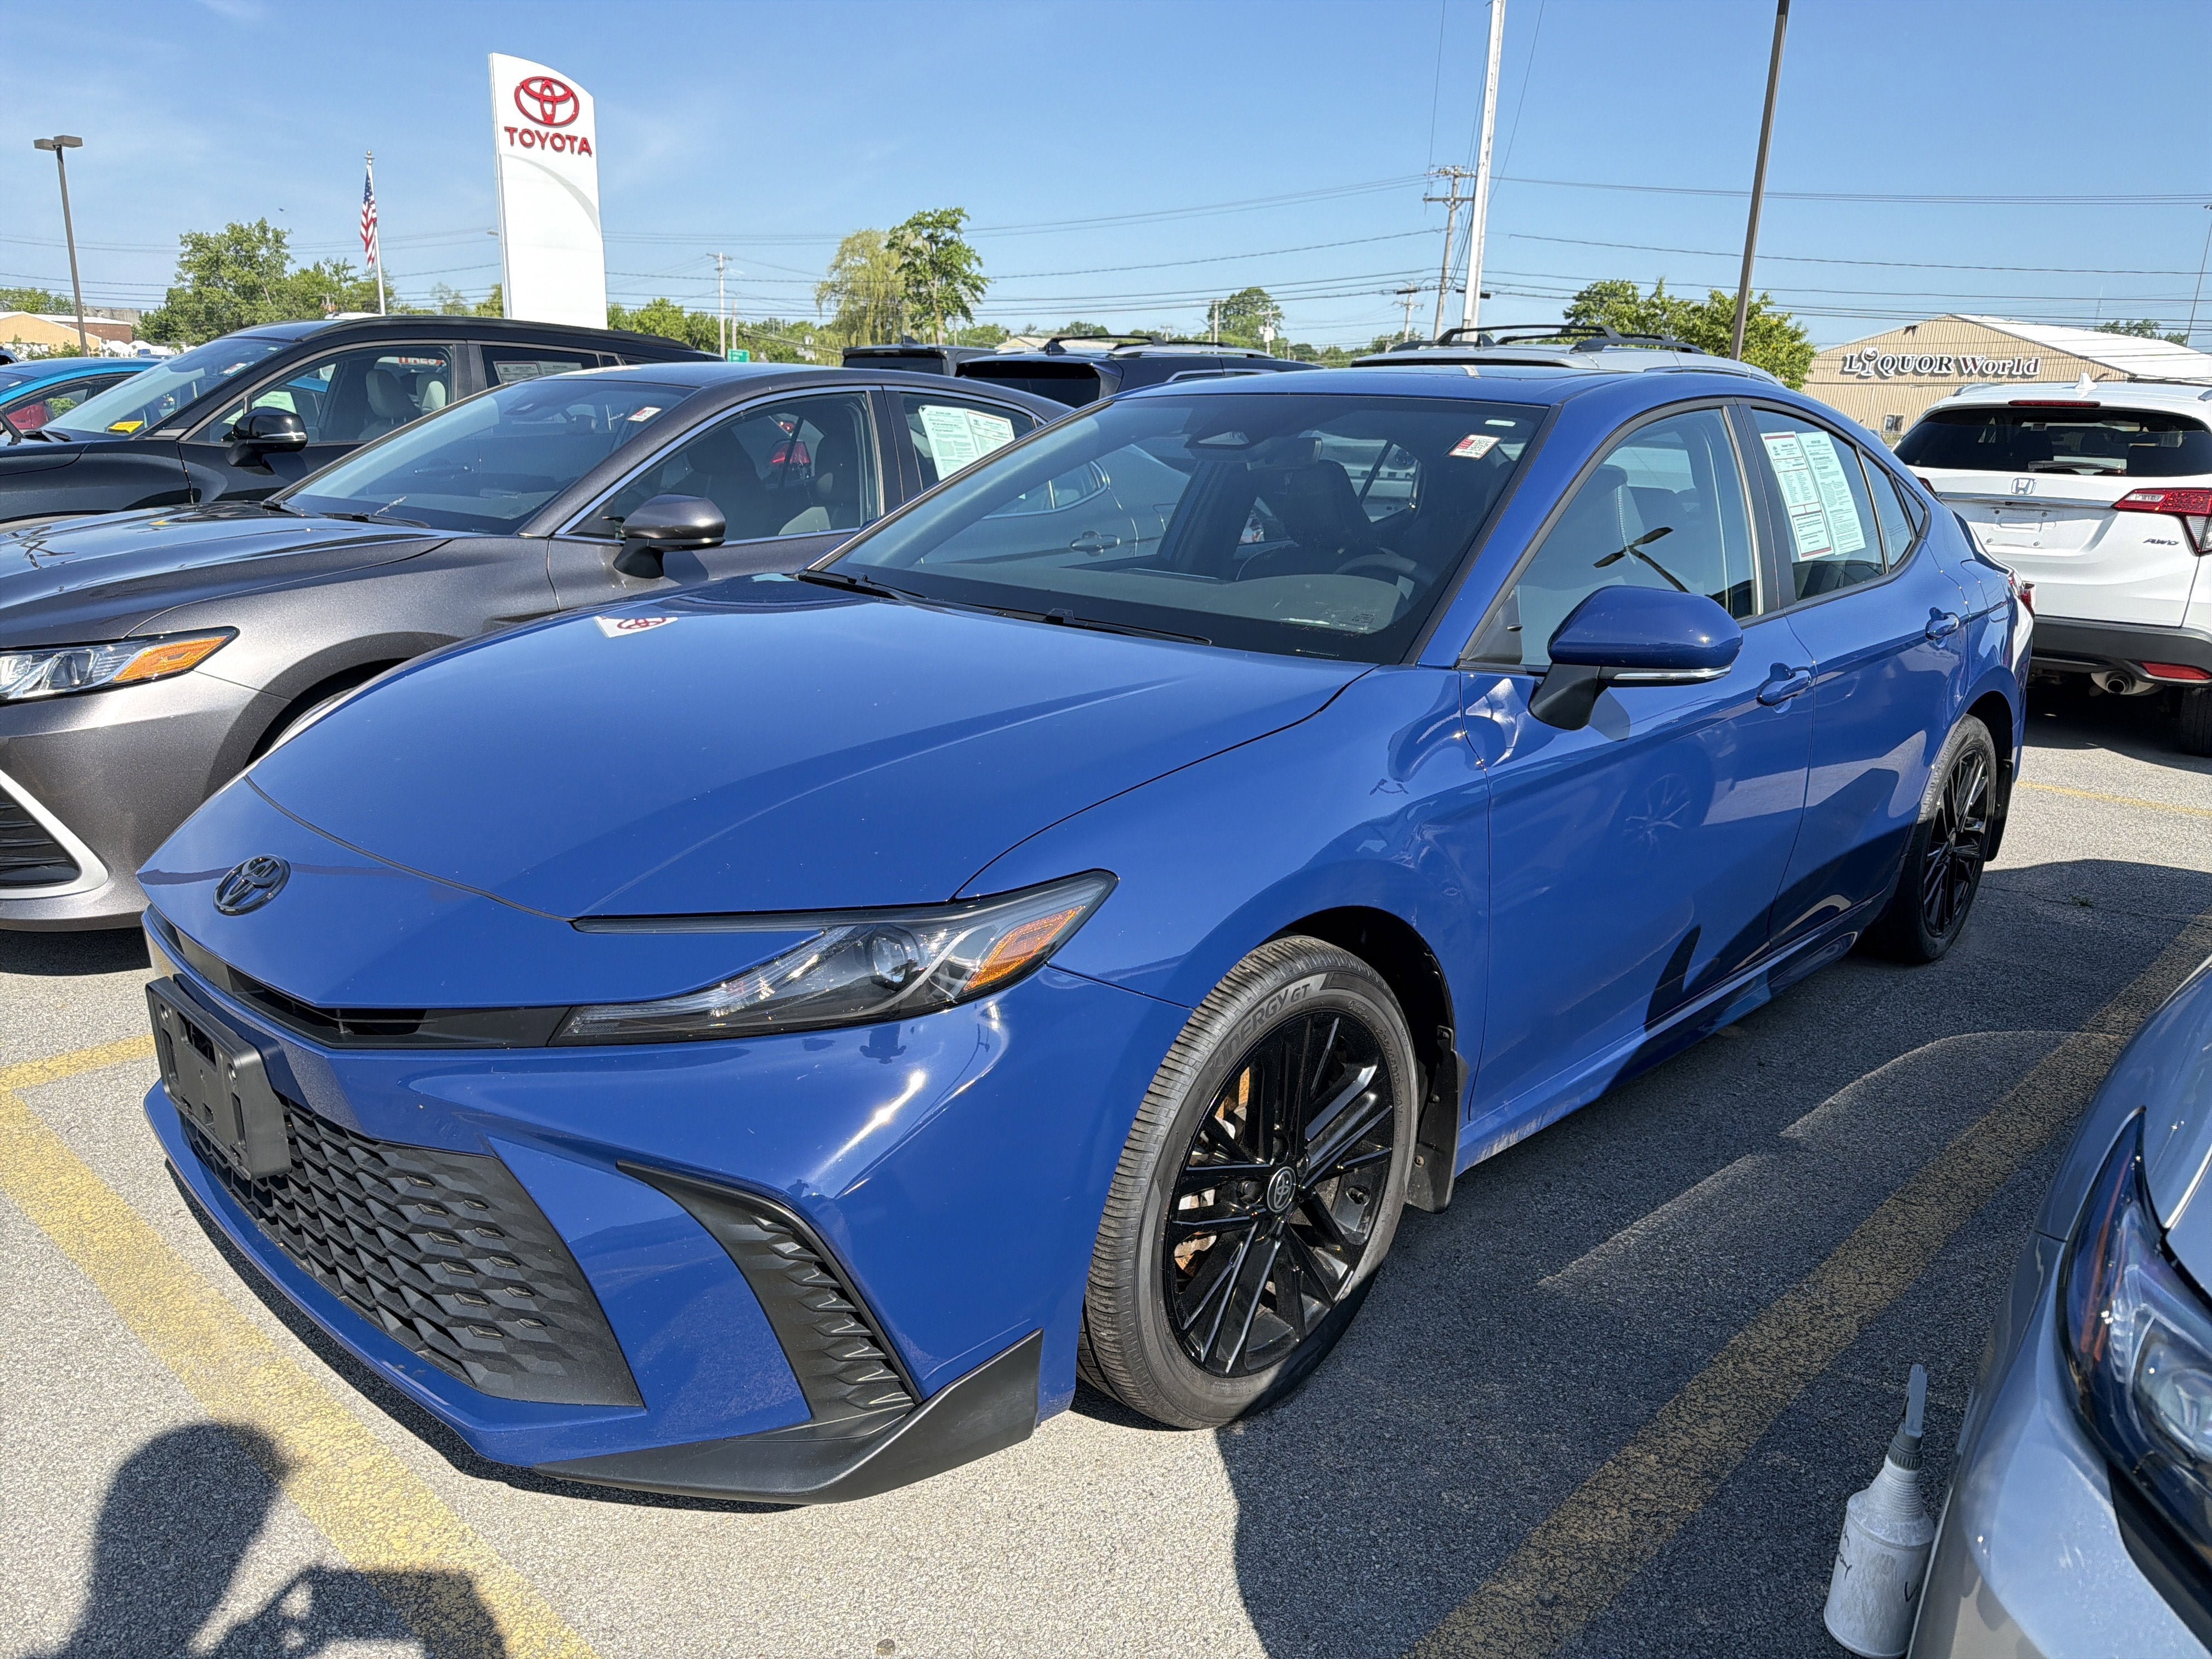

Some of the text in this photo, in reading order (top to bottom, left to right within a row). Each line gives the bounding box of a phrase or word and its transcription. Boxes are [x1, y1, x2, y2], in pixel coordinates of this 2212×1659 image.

[504, 126, 592, 157] TOYOTA
[1844, 347, 2041, 376] LIQUOR World
[1290, 983, 1311, 1003] GT
